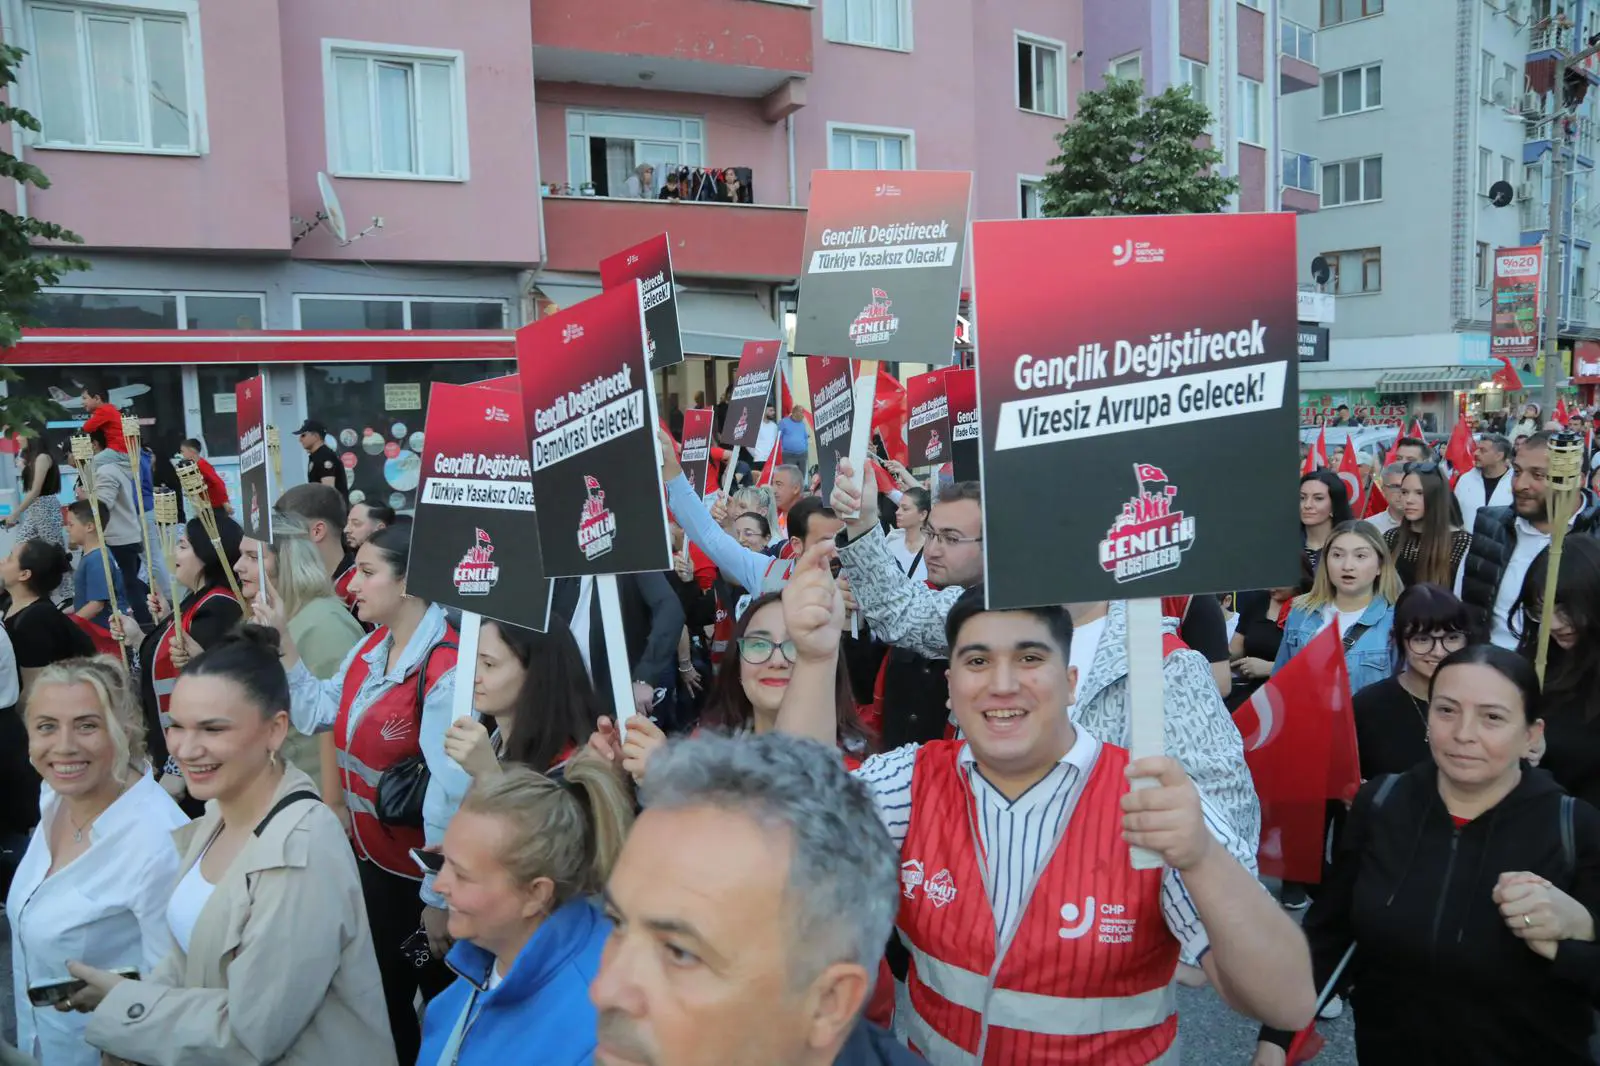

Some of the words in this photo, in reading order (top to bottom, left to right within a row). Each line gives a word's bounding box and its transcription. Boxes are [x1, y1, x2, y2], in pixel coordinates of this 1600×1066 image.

[822, 225, 867, 247] Gençlik
[869, 219, 948, 245] Değiştirecek
[818, 254, 856, 271] Türkiye
[859, 250, 902, 267] Yasaksız
[905, 246, 946, 264] Olacak!
[1014, 342, 1108, 390] Gençlik
[1113, 319, 1267, 377] Değiştirecek
[534, 399, 568, 433] Gençlik
[568, 363, 632, 418] Değiştirecek
[1018, 399, 1090, 438] Vizesiz
[1096, 390, 1171, 425] Avrupa
[1178, 371, 1265, 413] Gelecek!
[536, 420, 588, 467] Demokrasi
[590, 394, 640, 443] Gelecek!
[434, 452, 475, 478] Gençlik
[431, 482, 464, 501] Türkiye
[466, 484, 507, 504] Yasaksız
[1100, 903, 1125, 914] CHP
